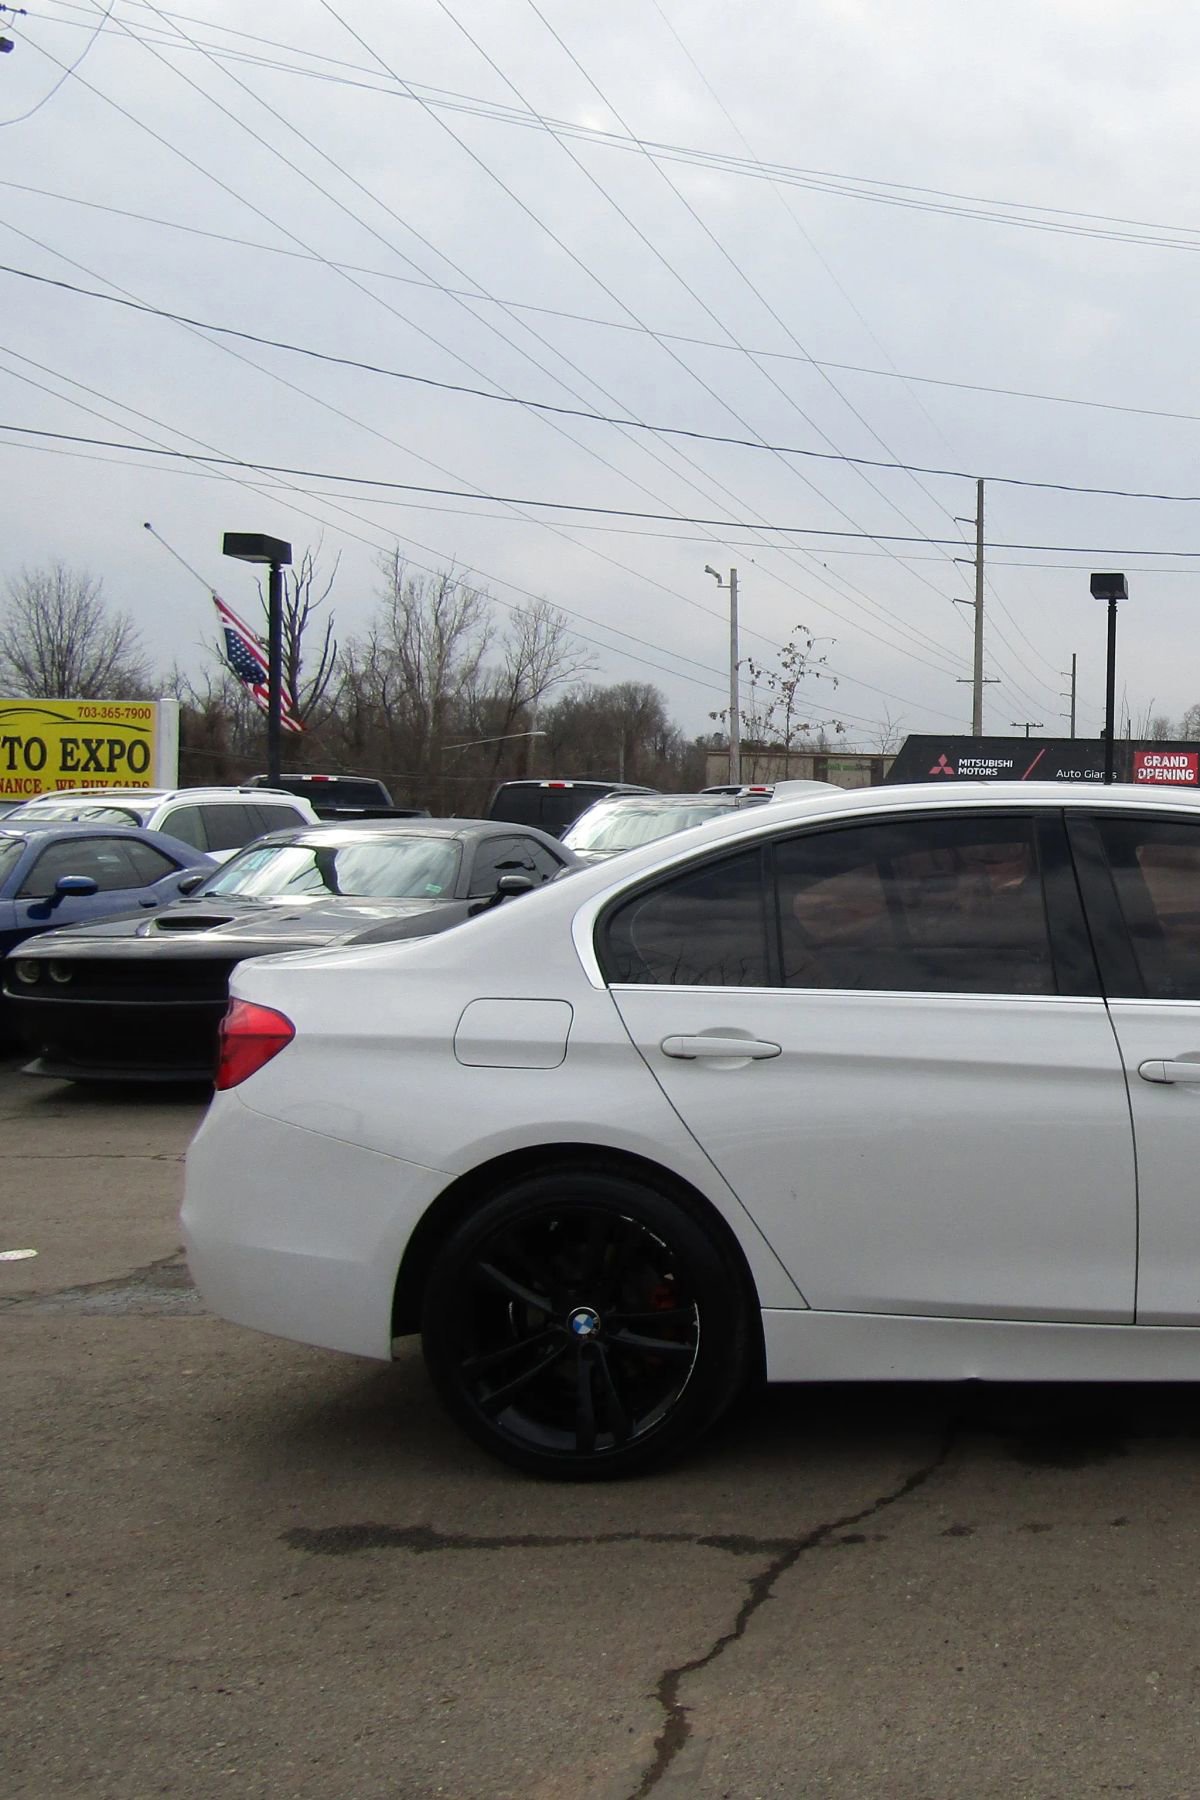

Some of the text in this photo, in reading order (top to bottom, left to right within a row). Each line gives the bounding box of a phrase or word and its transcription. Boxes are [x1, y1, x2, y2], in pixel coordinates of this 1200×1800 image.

[78, 706, 152, 719] 703-365-7900
[0, 735, 151, 774] TO EXPO
[958, 758, 1014, 768] MITSUBISHI
[1143, 755, 1189, 768] GRAND
[958, 767, 998, 776] MOTORS
[1056, 769, 1117, 780] Auto Gians
[1137, 767, 1195, 781] OPENING
